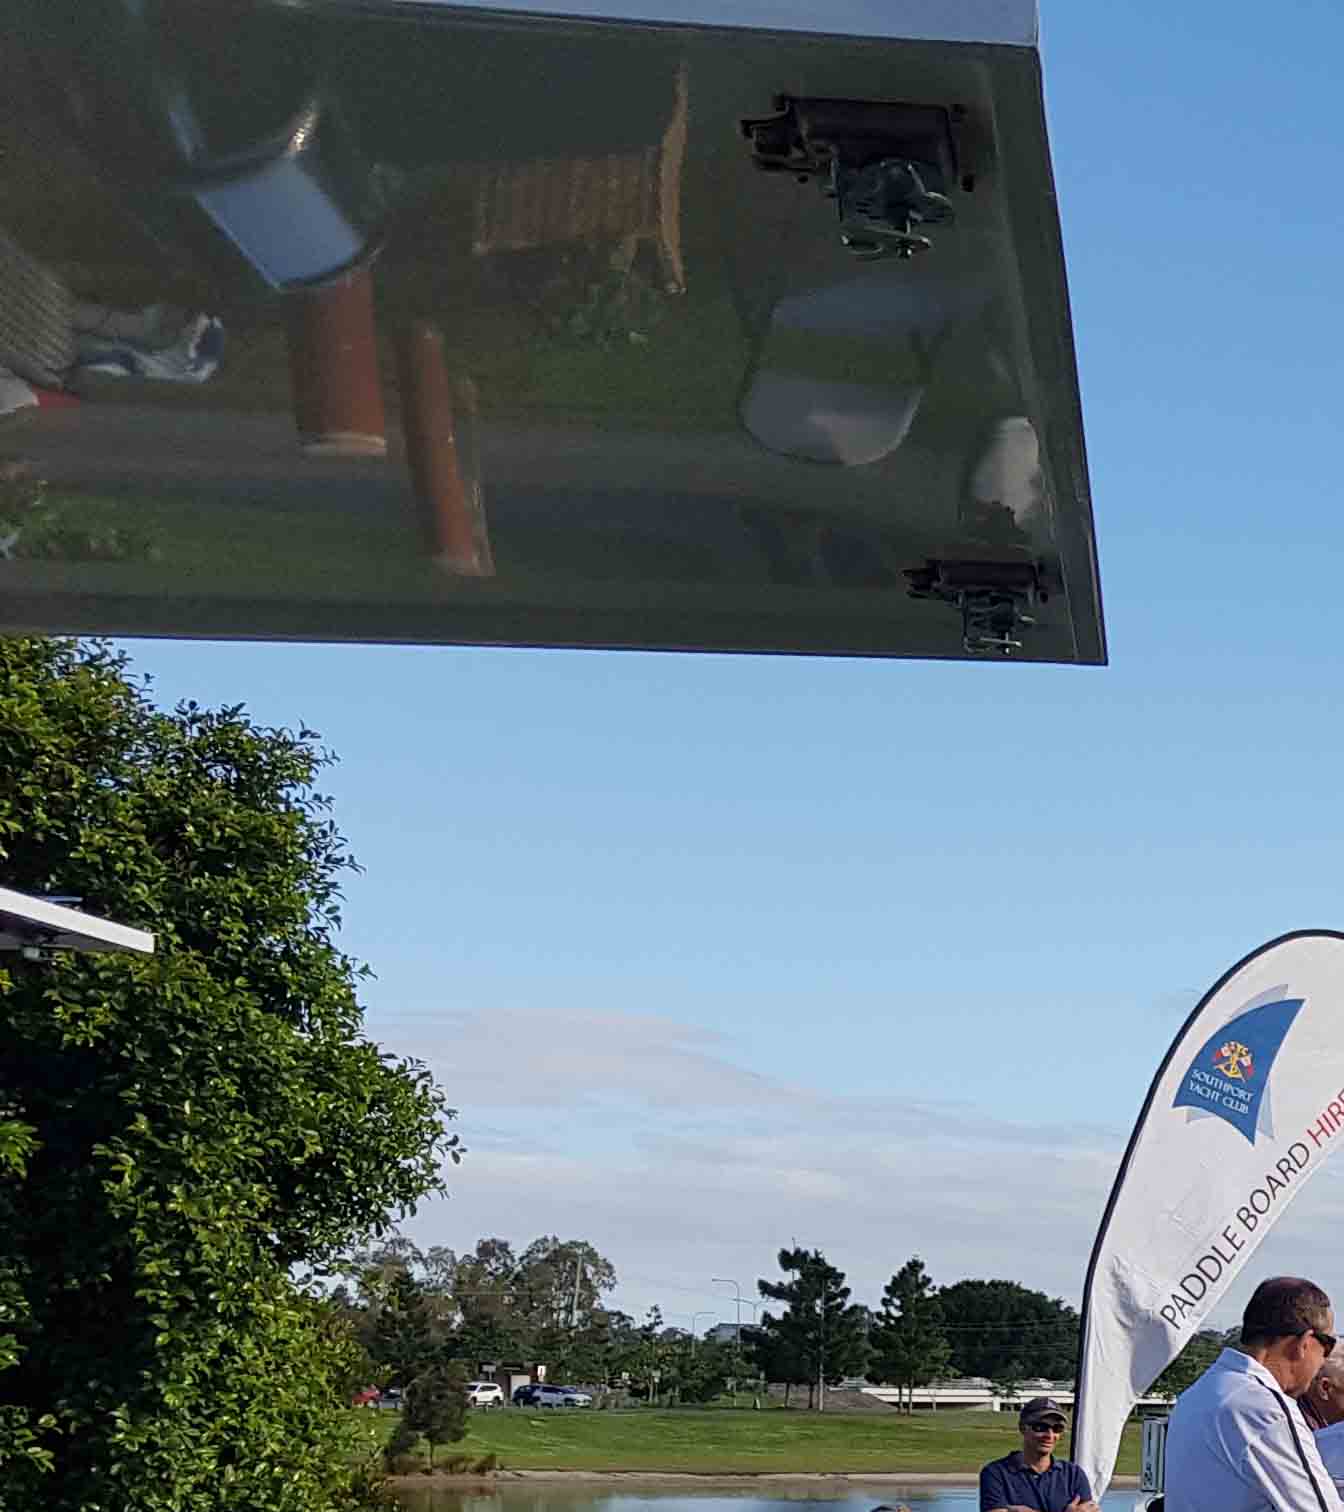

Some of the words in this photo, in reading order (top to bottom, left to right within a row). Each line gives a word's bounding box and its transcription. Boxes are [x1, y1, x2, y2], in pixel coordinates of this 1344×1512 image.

[1190, 1080, 1221, 1101] YACHT
[1222, 1097, 1249, 1114] CLUB
[1191, 1069, 1253, 1102] SOUTHPORT
[1160, 1225, 1246, 1330] PADDLE
[1236, 1142, 1310, 1232] BOARD
